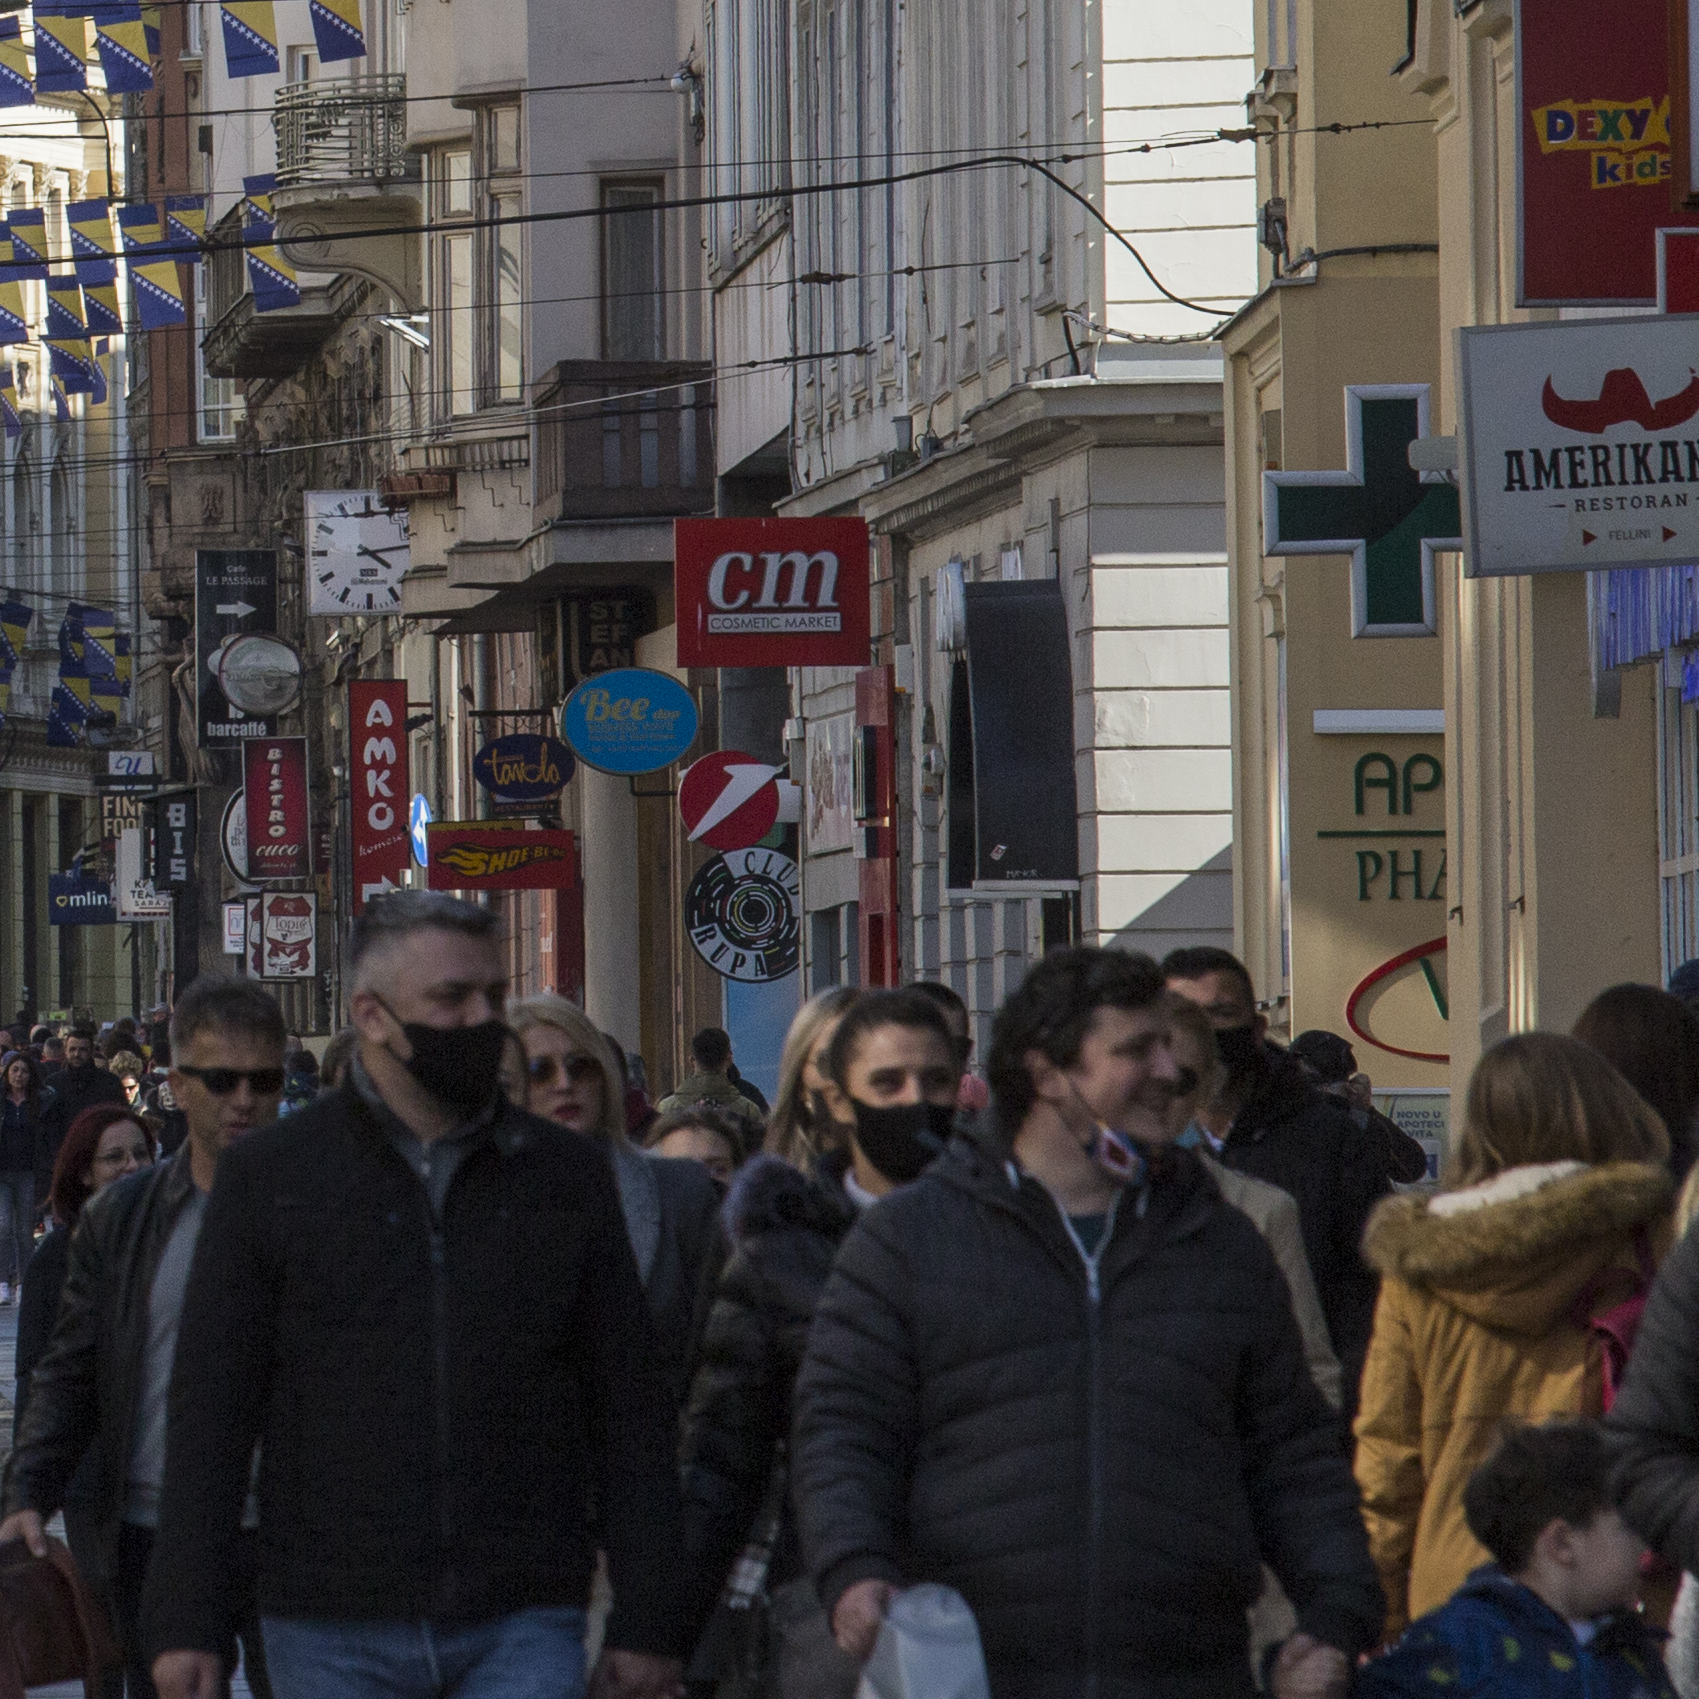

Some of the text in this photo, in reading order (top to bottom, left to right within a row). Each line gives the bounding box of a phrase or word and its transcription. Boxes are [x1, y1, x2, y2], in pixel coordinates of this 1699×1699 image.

[1546, 108, 1652, 144] DEXY
[1596, 154, 1672, 185] kids
[1574, 493, 1688, 513] RESTORAN
[1608, 528, 1651, 541] FELLINI
[205, 575, 267, 585] LE PASSAGE
[707, 550, 839, 611] cm
[710, 615, 838, 630] COSMETIC MARKET
[580, 687, 651, 722] Bee
[206, 722, 267, 738] barcaffé
[363, 699, 397, 831] AMKO
[267, 748, 287, 838] BISTRO
[1396, 1110, 1441, 1119] NOVO U
